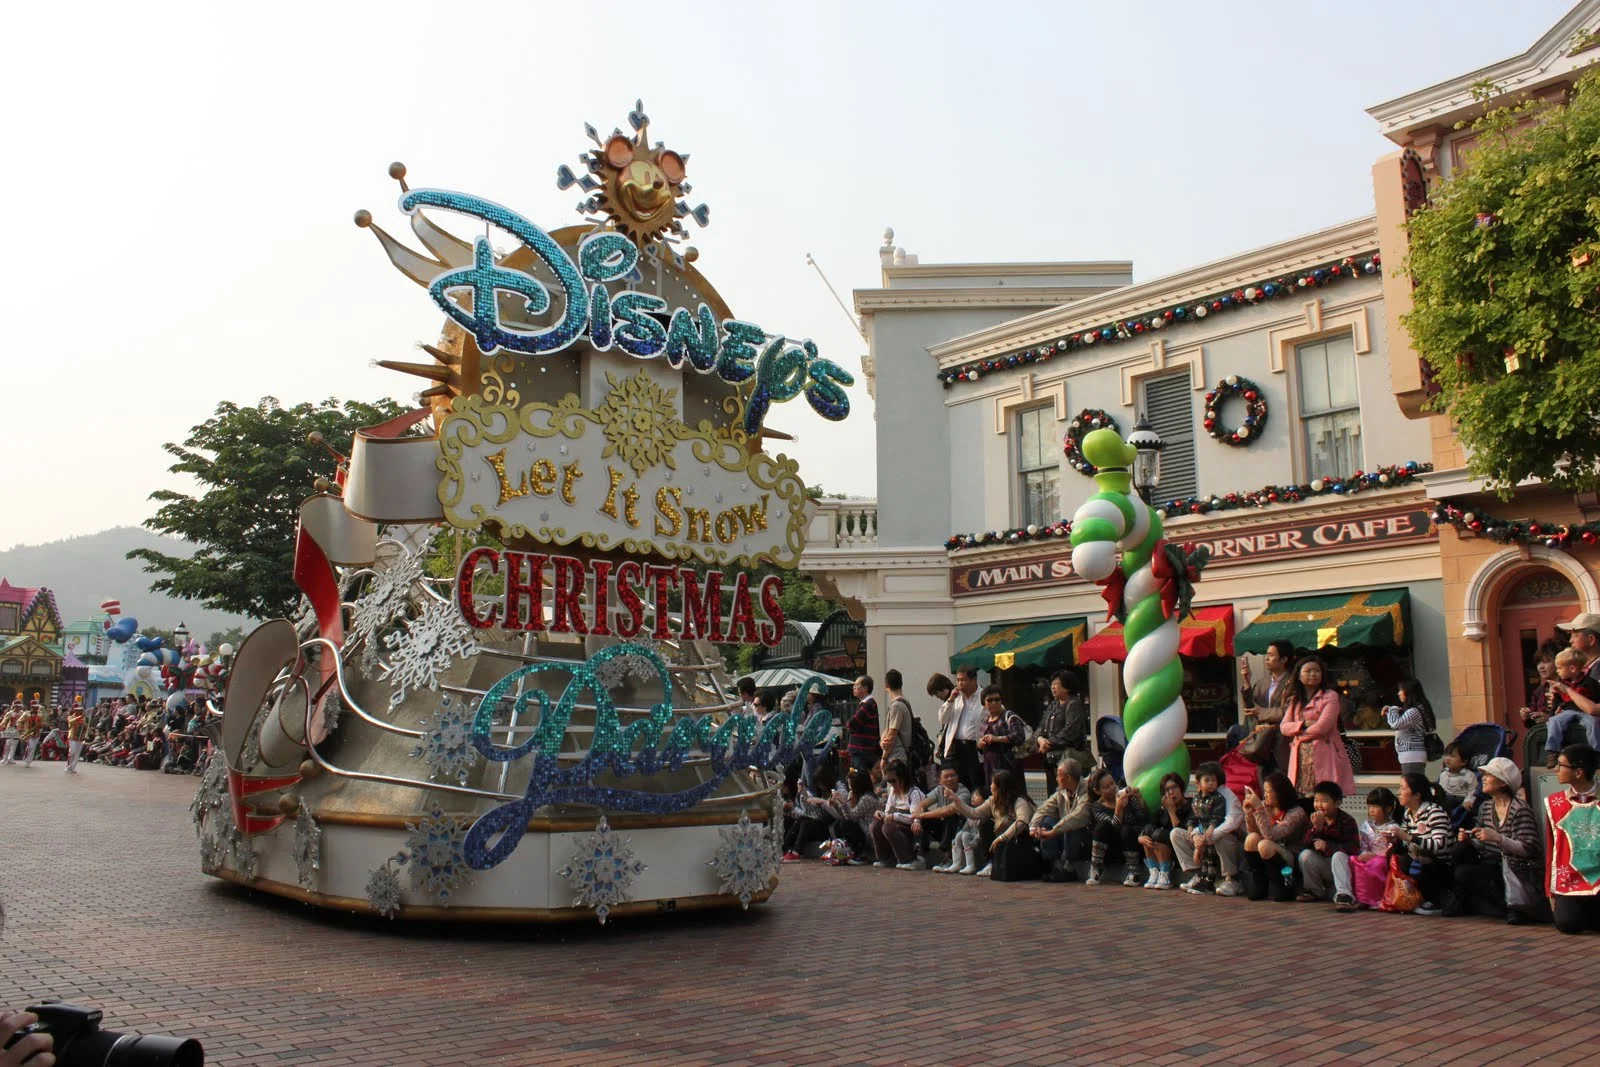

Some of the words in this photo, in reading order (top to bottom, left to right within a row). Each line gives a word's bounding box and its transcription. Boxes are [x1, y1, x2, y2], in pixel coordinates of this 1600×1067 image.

[485, 447, 584, 507] Let
[597, 464, 642, 530] It
[653, 484, 770, 546] Snow
[456, 546, 785, 648] CHRISTMAS
[976, 563, 1044, 587] MAIN
[1312, 514, 1416, 546] CAFE
[462, 643, 838, 870] Parade
